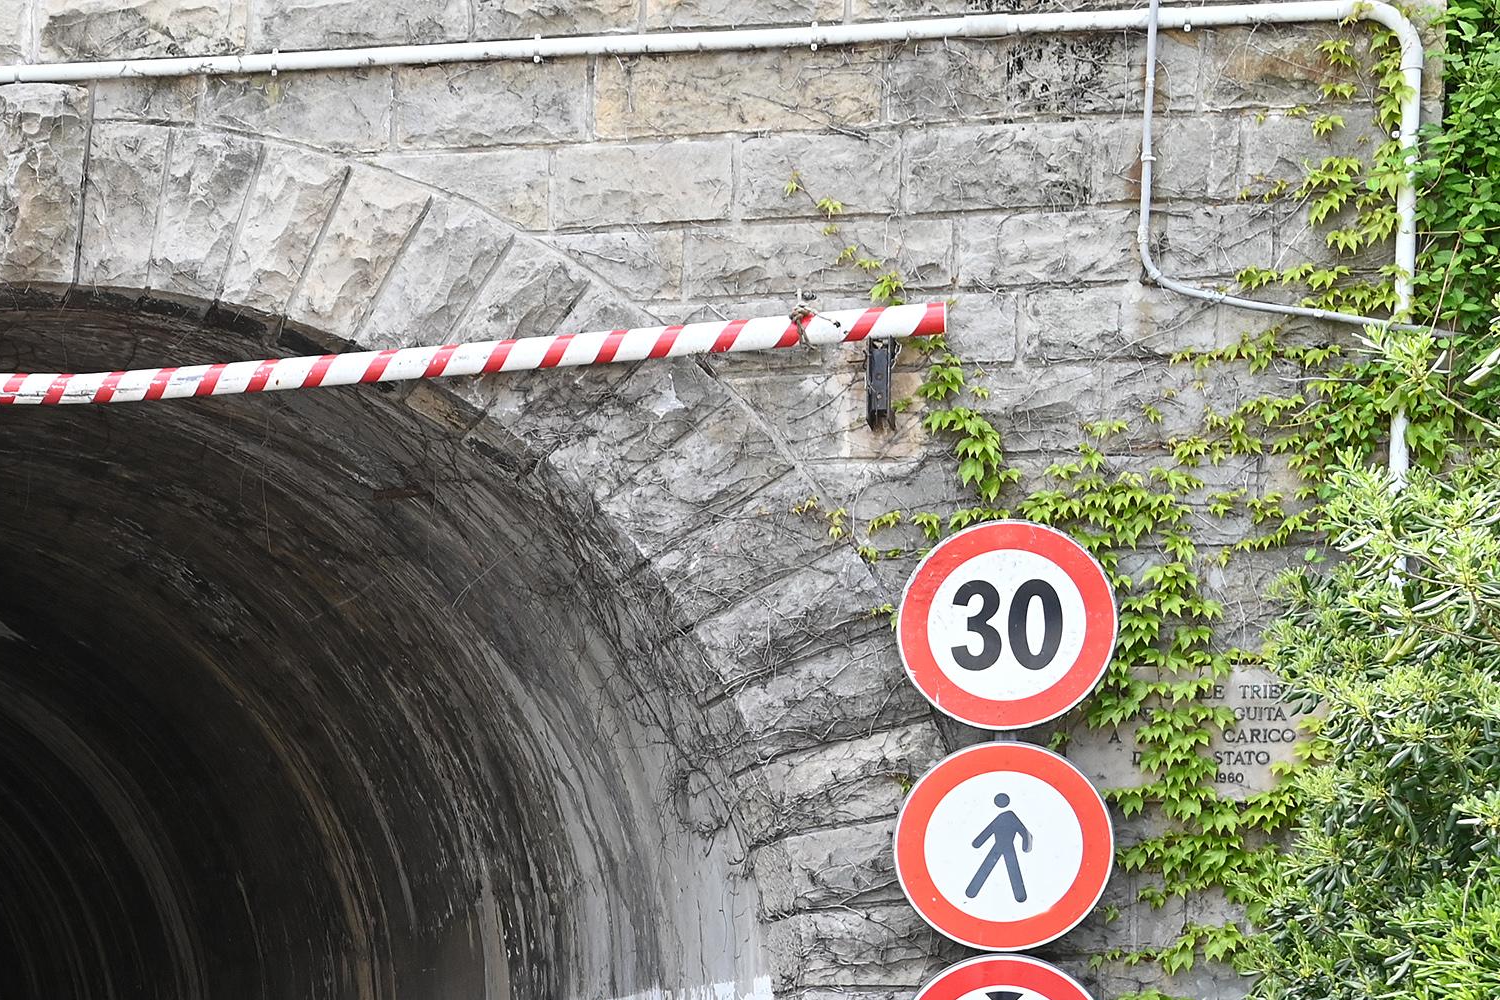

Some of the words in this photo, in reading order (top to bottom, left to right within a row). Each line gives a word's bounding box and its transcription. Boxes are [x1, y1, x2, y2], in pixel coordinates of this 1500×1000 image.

[950, 578, 1063, 671] 30
[1238, 684, 1284, 699] TRIE
[1233, 706, 1287, 721] GUITA
[1223, 728, 1296, 743] CARICO
[1214, 750, 1270, 765] STATO
[1214, 772, 1244, 784] 1960
